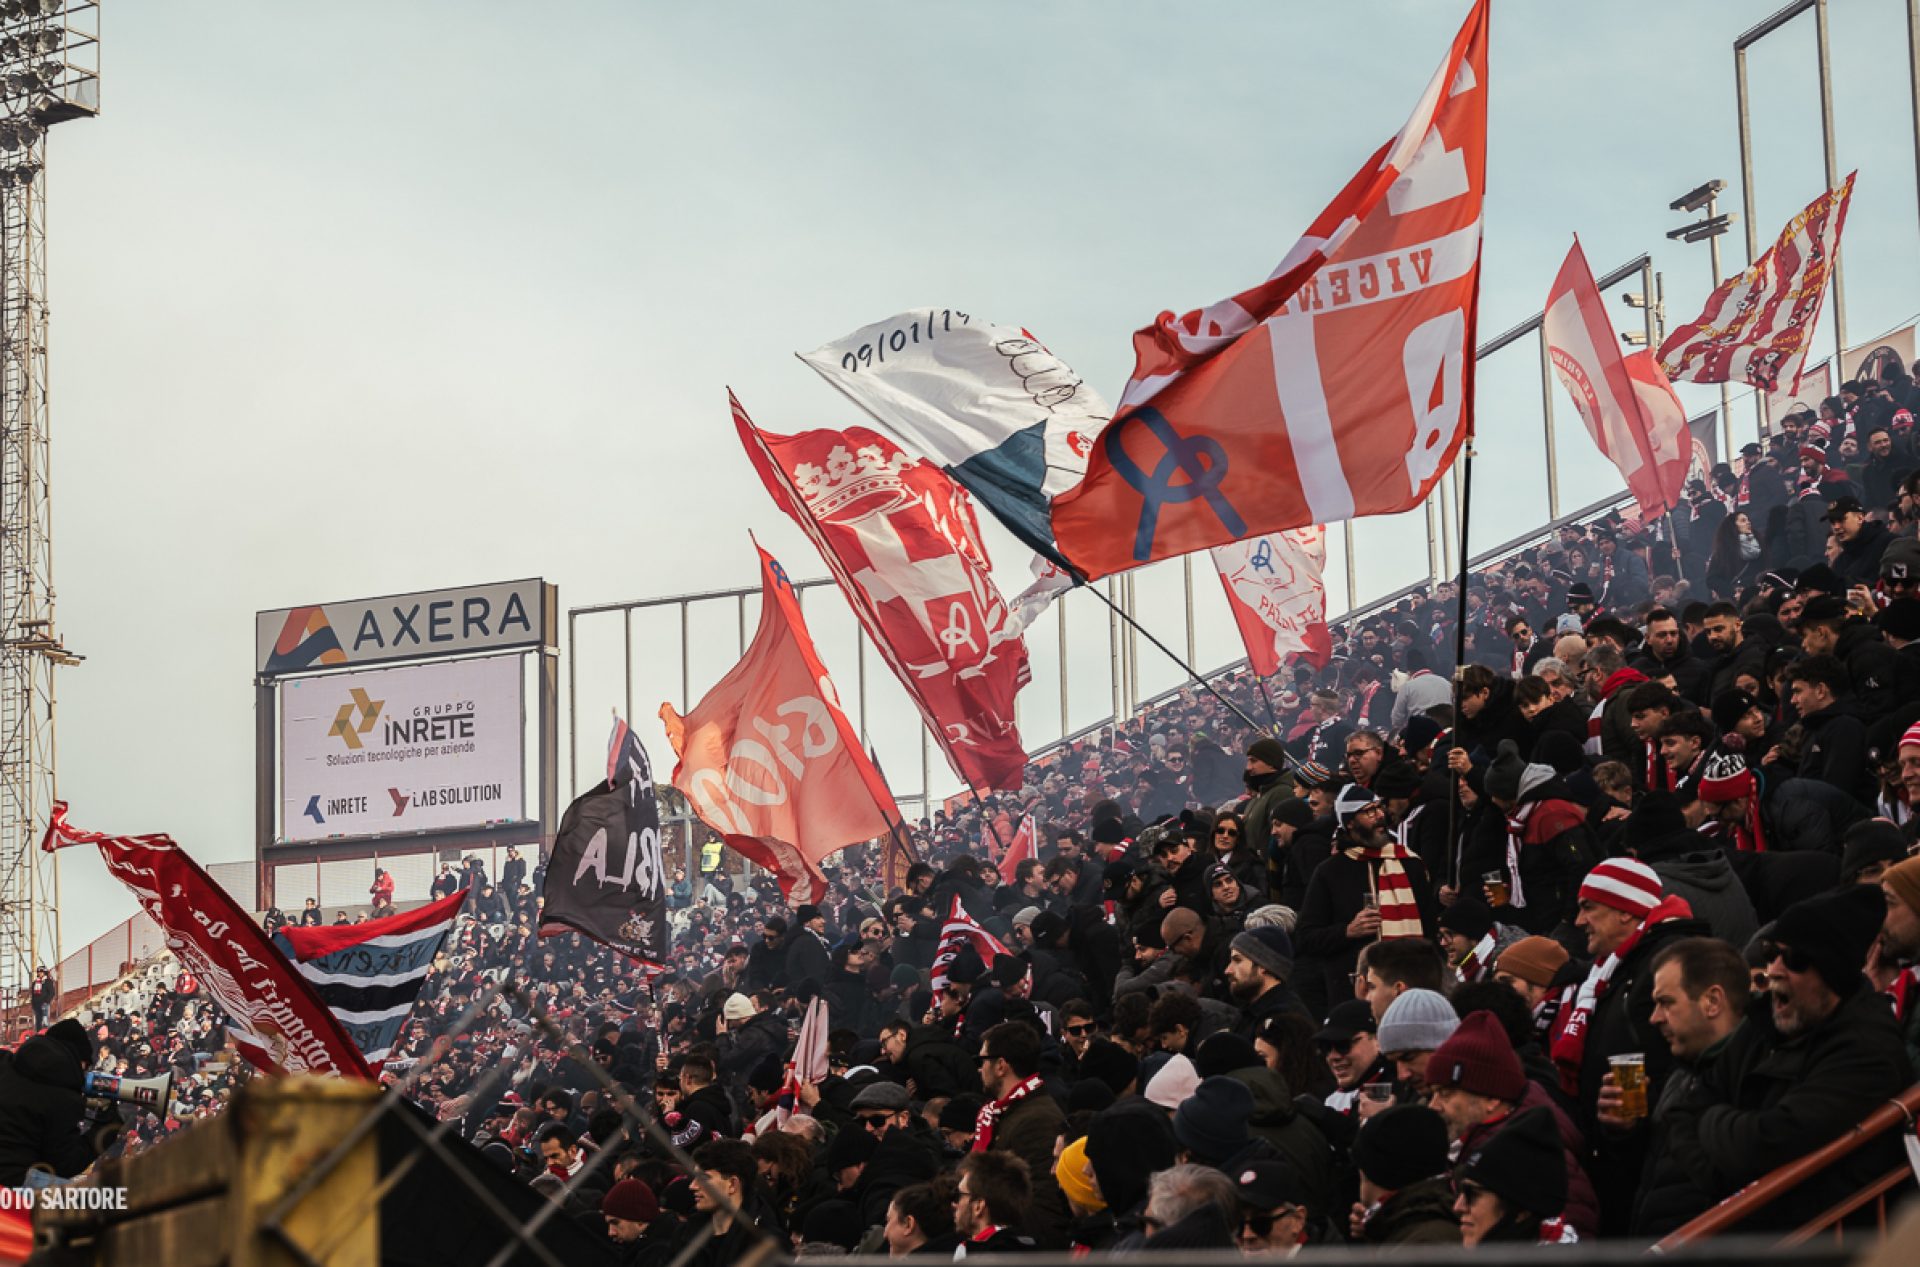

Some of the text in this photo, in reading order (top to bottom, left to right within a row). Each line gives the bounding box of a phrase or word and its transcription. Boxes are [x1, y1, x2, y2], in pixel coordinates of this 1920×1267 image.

[353, 592, 531, 651] AXERA
[413, 701, 475, 717] GRUPPO
[327, 741, 475, 766] Soluzioni tecnologiche per aziende
